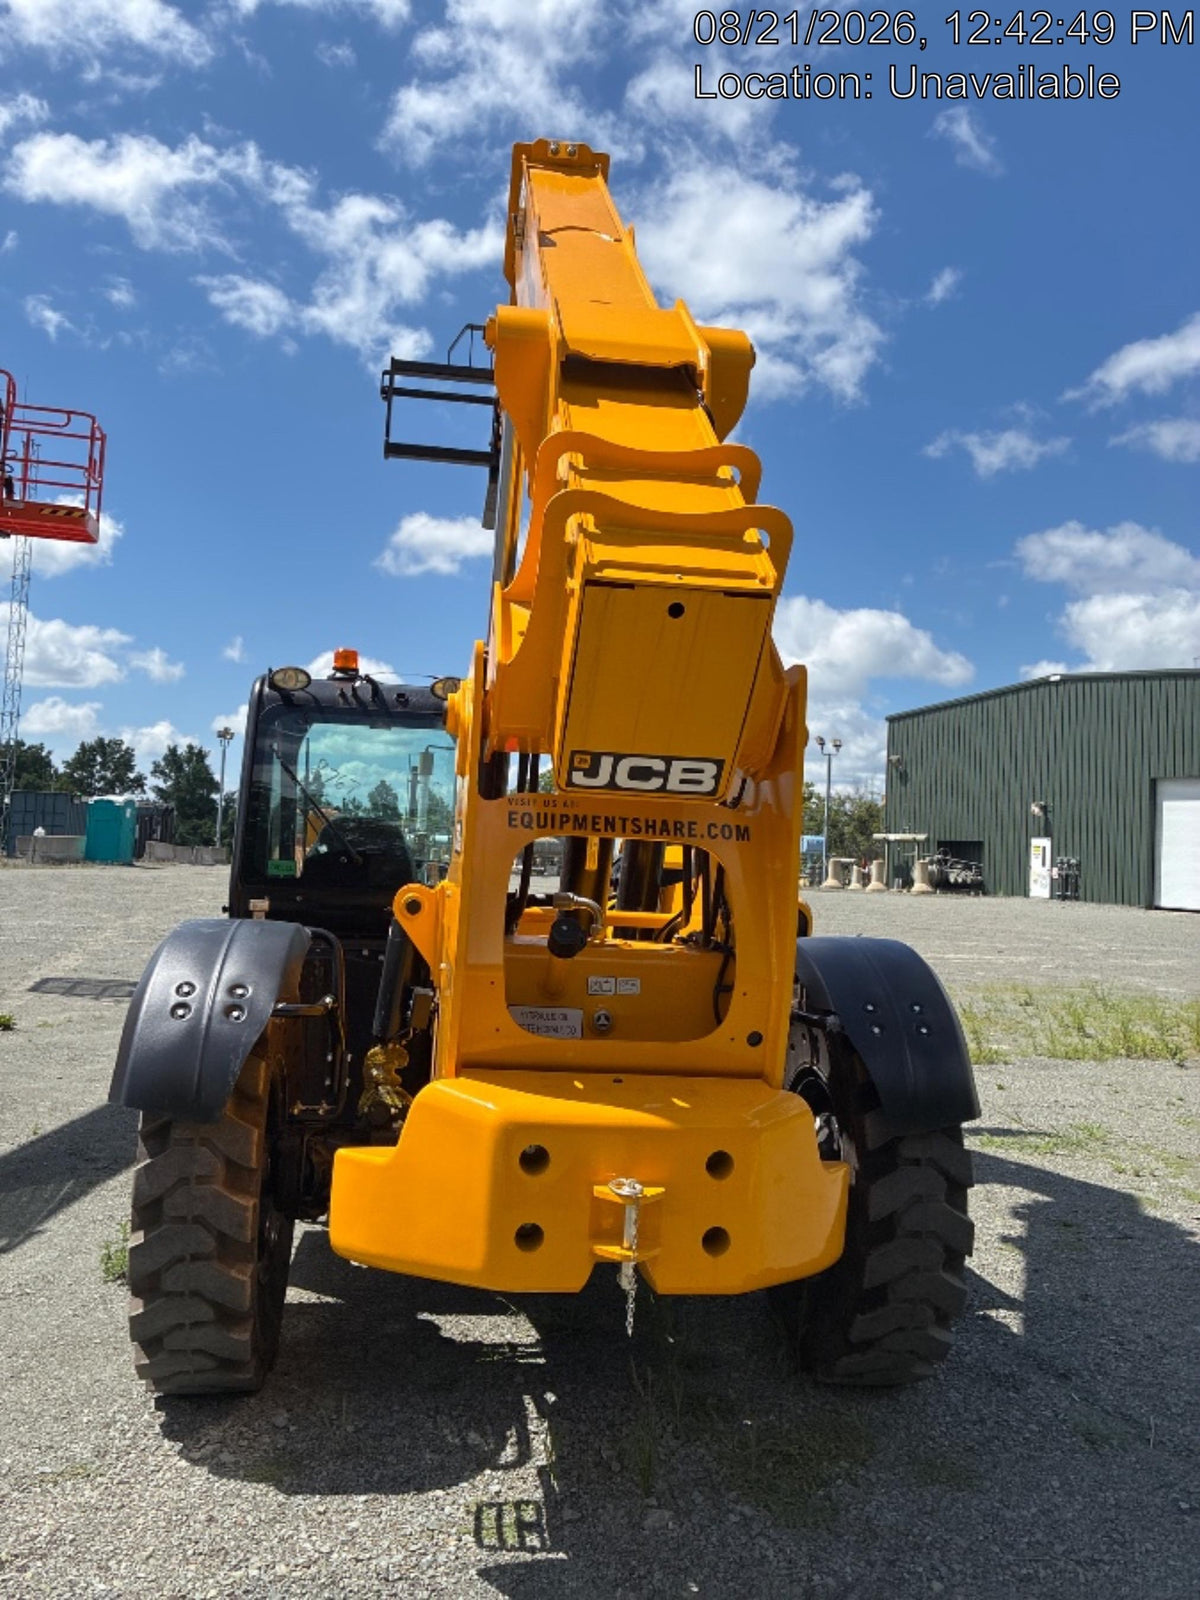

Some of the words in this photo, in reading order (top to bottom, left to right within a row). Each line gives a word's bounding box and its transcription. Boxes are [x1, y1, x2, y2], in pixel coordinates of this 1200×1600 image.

[571, 754, 718, 793] JCB
[543, 799, 557, 808] US
[507, 810, 751, 842] EQUIPMENTSHARE.COM
